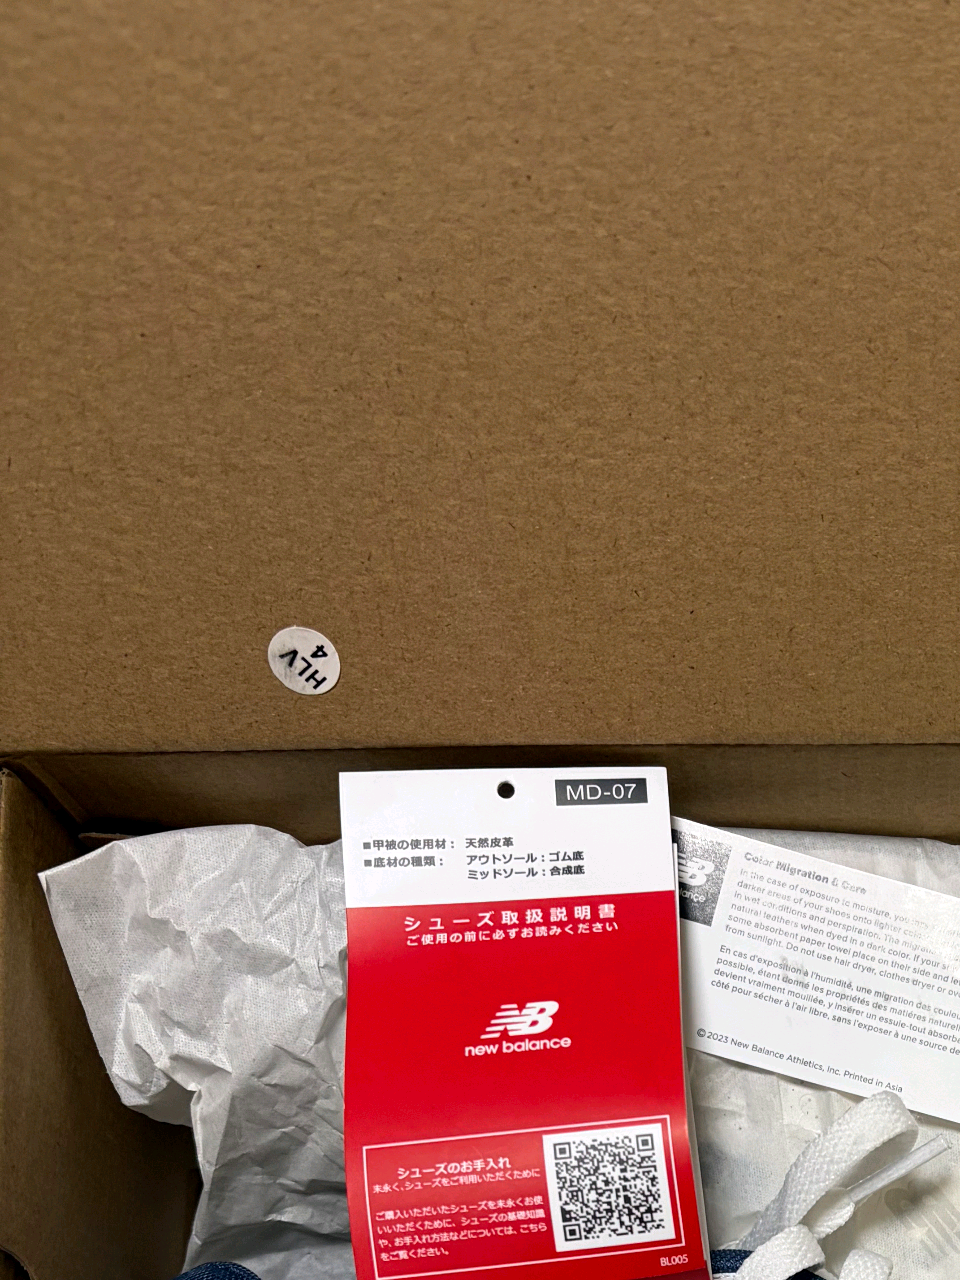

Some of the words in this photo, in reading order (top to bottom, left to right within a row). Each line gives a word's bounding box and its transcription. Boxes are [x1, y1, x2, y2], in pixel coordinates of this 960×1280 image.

[279, 649, 327, 690] HLV
[310, 645, 328, 658] 4
[566, 783, 637, 801] MD-07
[465, 837, 514, 849] 天然皮革
[750, 872, 765, 882] the
[766, 878, 787, 889] case
[788, 884, 799, 892] of
[799, 888, 840, 905] exposure
[852, 902, 892, 919] moisture,
[893, 914, 910, 925] you
[775, 861, 830, 884] Migration
[404, 904, 616, 932] シューズ取扱説明書
[733, 892, 743, 900] in
[744, 895, 761, 905] wet
[762, 900, 808, 919] conditions
[808, 914, 826, 924] and
[826, 919, 882, 941] perspiration.
[883, 934, 900, 945] The
[736, 881, 766, 895] darker
[793, 897, 803, 905] of
[803, 901, 824, 912] your
[824, 906, 851, 919] shoes
[852, 914, 873, 925] onto
[873, 919, 902, 934] lighter
[406, 922, 619, 947] ご使用の前に必ずお読みください
[724, 925, 746, 937] from
[746, 932, 784, 949] sunlight.
[785, 942, 799, 952] Do
[800, 947, 816, 957] not
[816, 952, 833, 962] use
[834, 956, 851, 967] hair
[852, 961, 878, 976] dryer,
[878, 969, 911, 984] clothes
[911, 978, 936, 991] dryer
[936, 986, 947, 994] or
[727, 915, 752, 927] some
[753, 922, 799, 940] absorbent
[799, 935, 826, 949] paper
[827, 942, 852, 955] towel
[851, 950, 876, 963] place
[877, 958, 889, 966] on
[890, 960, 911, 972] their
[911, 966, 931, 978] side
[932, 972, 950, 983] and
[730, 903, 762, 917] natural
[763, 912, 799, 928] leathers
[800, 923, 825, 936] when
[825, 930, 849, 943] dyed
[849, 936, 858, 945] in
[866, 941, 887, 953] dark
[887, 948, 912, 960] color.
[913, 954, 921, 962] If
[920, 957, 941, 969] your
[713, 968, 747, 984] devient
[747, 978, 786, 995] vraiment
[786, 989, 827, 1007] mouillée,
[827, 1001, 834, 1009] y
[834, 1002, 865, 1017] insérer
[865, 1012, 877, 1020] un
[878, 1015, 927, 1034] essuie-tout
[716, 957, 756, 975] possible,
[757, 968, 781, 981] étant
[781, 974, 810, 990] donné
[811, 983, 825, 994] les
[825, 988, 871, 1007] propriétés
[871, 1001, 888, 1011] des
[719, 945, 732, 955] En
[732, 950, 748, 960] cas
[749, 954, 804, 976] d'exposition
[802, 969, 810, 978] à
[855, 985, 873, 995] une
[873, 989, 915, 1008] migration
[915, 1000, 932, 1012] des
[710, 979, 731, 991] côté
[730, 985, 753, 998] pour
[753, 991, 784, 1005] sécher
[784, 999, 791, 1008] à
[791, 1001, 808, 1013] l'air
[808, 1006, 831, 1020] libre,
[831, 1014, 852, 1025] sans
[852, 1019, 893, 1037] l'exposer
[893, 1030, 900, 1038] à
[900, 1033, 918, 1043] une
[918, 1039, 948, 1052] source
[949, 1046, 960, 1056] de
[464, 1042, 498, 1057] new
[502, 1036, 572, 1054] balance
[730, 1037, 750, 1050] New
[751, 1043, 785, 1060] Balance
[785, 1054, 826, 1072] Athletics,
[826, 1065, 842, 1076] Inc.
[843, 1069, 874, 1085] Printed
[875, 1078, 884, 1087] in
[884, 1081, 903, 1093] Asia
[397, 1157, 511, 1180] シューズのお手入れ
[660, 1254, 688, 1267] BL005
